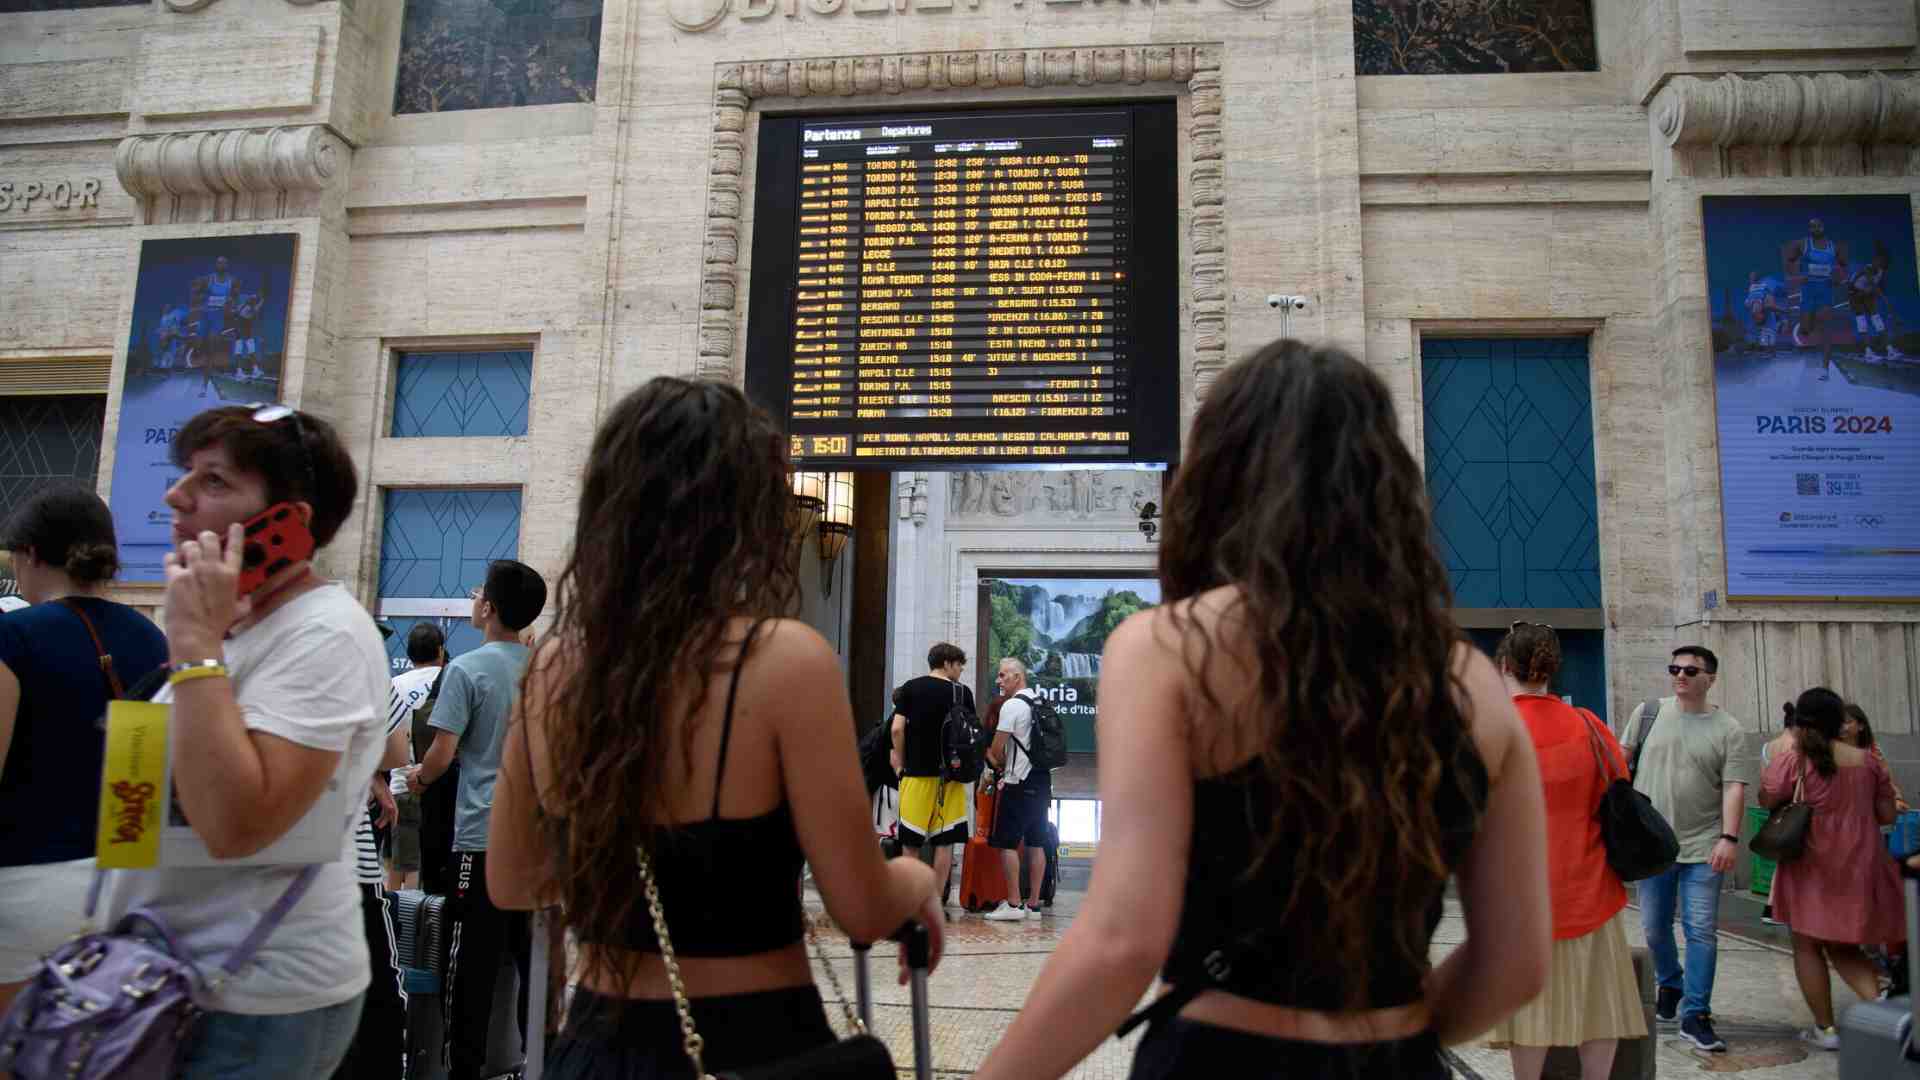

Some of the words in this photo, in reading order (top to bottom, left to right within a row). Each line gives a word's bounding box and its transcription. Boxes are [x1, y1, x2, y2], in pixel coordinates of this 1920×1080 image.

[804, 130, 861, 141] Partenze
[882, 126, 932, 138] Departures
[866, 174, 896, 182] TORINO
[1008, 169, 1038, 178] TORINO
[1057, 168, 1079, 176] SUSA
[866, 187, 896, 195] TORINO
[1012, 182, 1043, 190] TORINO
[1061, 180, 1084, 189] SUSA
[865, 199, 896, 208] NAPOLI
[865, 212, 896, 220] TORINO
[864, 238, 894, 246] TORINO
[1047, 232, 1078, 241] TORINO
[863, 250, 891, 259] LECCE
[859, 343, 891, 351] ZURICH
[859, 356, 898, 364] SALERNO
[1033, 352, 1076, 361] BUSINESS
[859, 369, 890, 377] NAPOLI
[859, 383, 889, 391] TORINO
[859, 396, 895, 405] TRIESTE
[1091, 393, 1103, 402] 12
[857, 410, 886, 418] PARMA
[1091, 407, 1103, 416] 22
[1757, 415, 1826, 434] PARIS
[1833, 415, 1893, 434] 2024
[814, 437, 847, 455] 15:01
[983, 447, 995, 455] LA
[1000, 446, 1028, 455] LINEA
[1032, 446, 1066, 455] GIALLA
[458, 854, 473, 889] ZEUS
